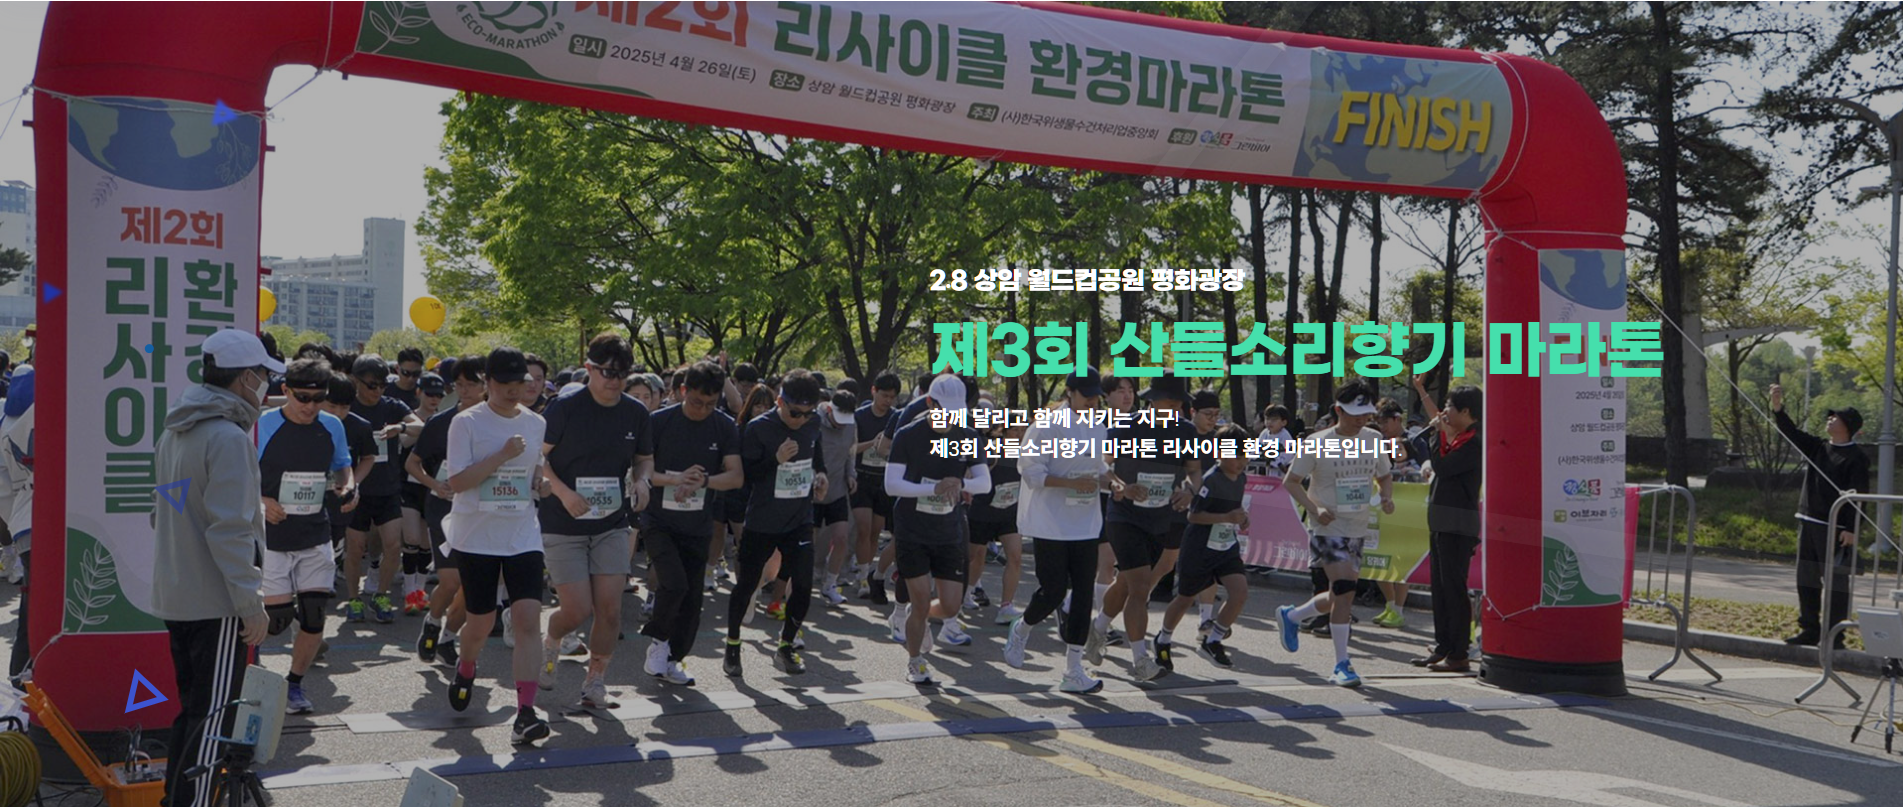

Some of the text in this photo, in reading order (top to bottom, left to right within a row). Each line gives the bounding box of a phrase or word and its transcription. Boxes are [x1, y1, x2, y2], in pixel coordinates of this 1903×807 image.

[461, 13, 558, 49] ECO-MARATHON
[573, 36, 603, 57] 일시
[610, 45, 757, 84] 2025년 4월 26일(토)
[774, 1, 1008, 90] 리사이클
[1029, 39, 1286, 125] 환경마라톤
[774, 71, 801, 89] 장소
[808, 80, 958, 114] 상암 월드컵공원 평화광장
[971, 106, 997, 122] 주최
[1332, 90, 1492, 153] FINISH
[120, 206, 224, 250] 제2회
[1575, 391, 1602, 400] 2025년
[293, 491, 316, 501] 10117
[492, 486, 519, 496] 15136
